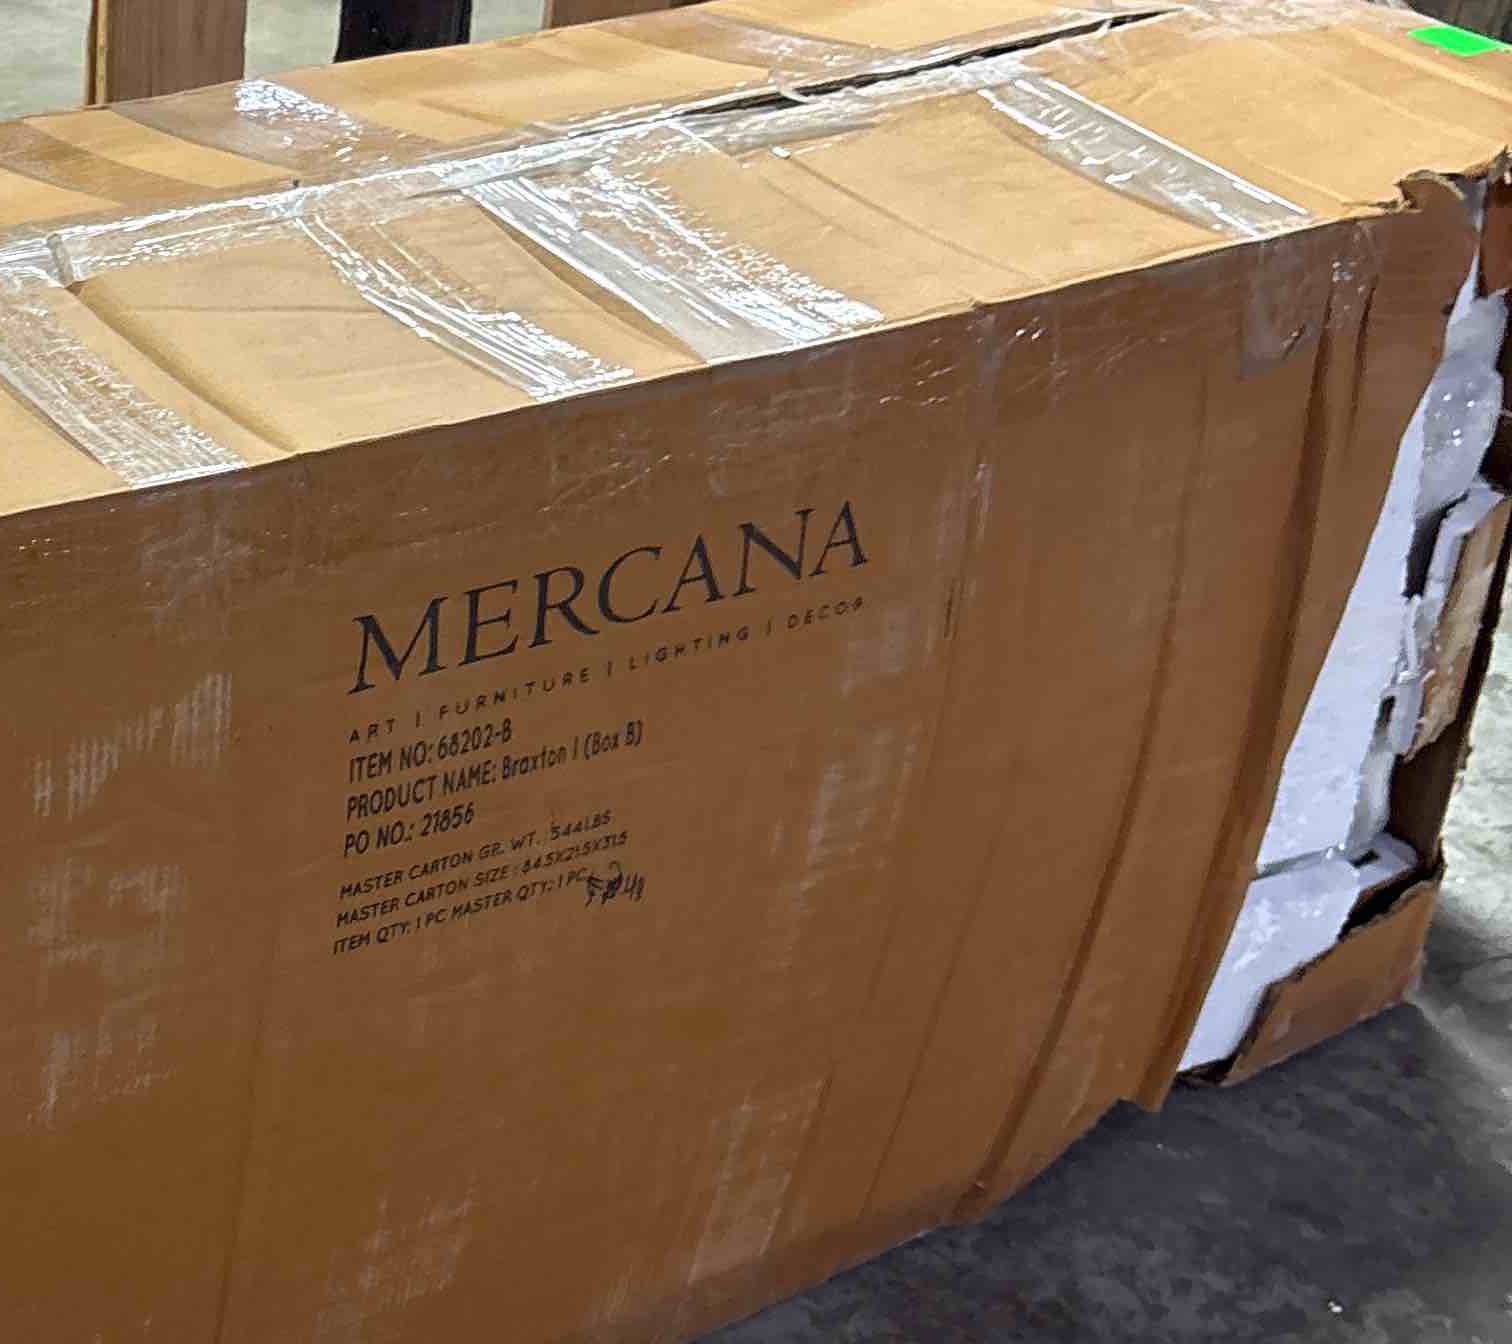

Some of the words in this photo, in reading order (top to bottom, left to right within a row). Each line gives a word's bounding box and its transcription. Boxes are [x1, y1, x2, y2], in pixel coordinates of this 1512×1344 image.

[347, 499, 869, 695] MERCANA
[348, 718, 395, 745] ART
[439, 666, 590, 721] FURNITURE
[629, 625, 749, 671] LIGHTING
[347, 774, 437, 821] PRODUCT
[441, 759, 497, 797] NAME:
[501, 744, 567, 781] Braxton
[584, 730, 620, 761] (Box
[348, 752, 392, 785] ITEM
[399, 739, 433, 770] NO:
[344, 829, 370, 857] PO
[335, 898, 399, 928] MASTER
[404, 878, 469, 908] CARTON
[339, 869, 403, 899] MASTER
[408, 852, 473, 881] CARTON
[333, 930, 370, 955] ITEM
[425, 908, 445, 929] PC
[452, 887, 513, 918] MASTER
